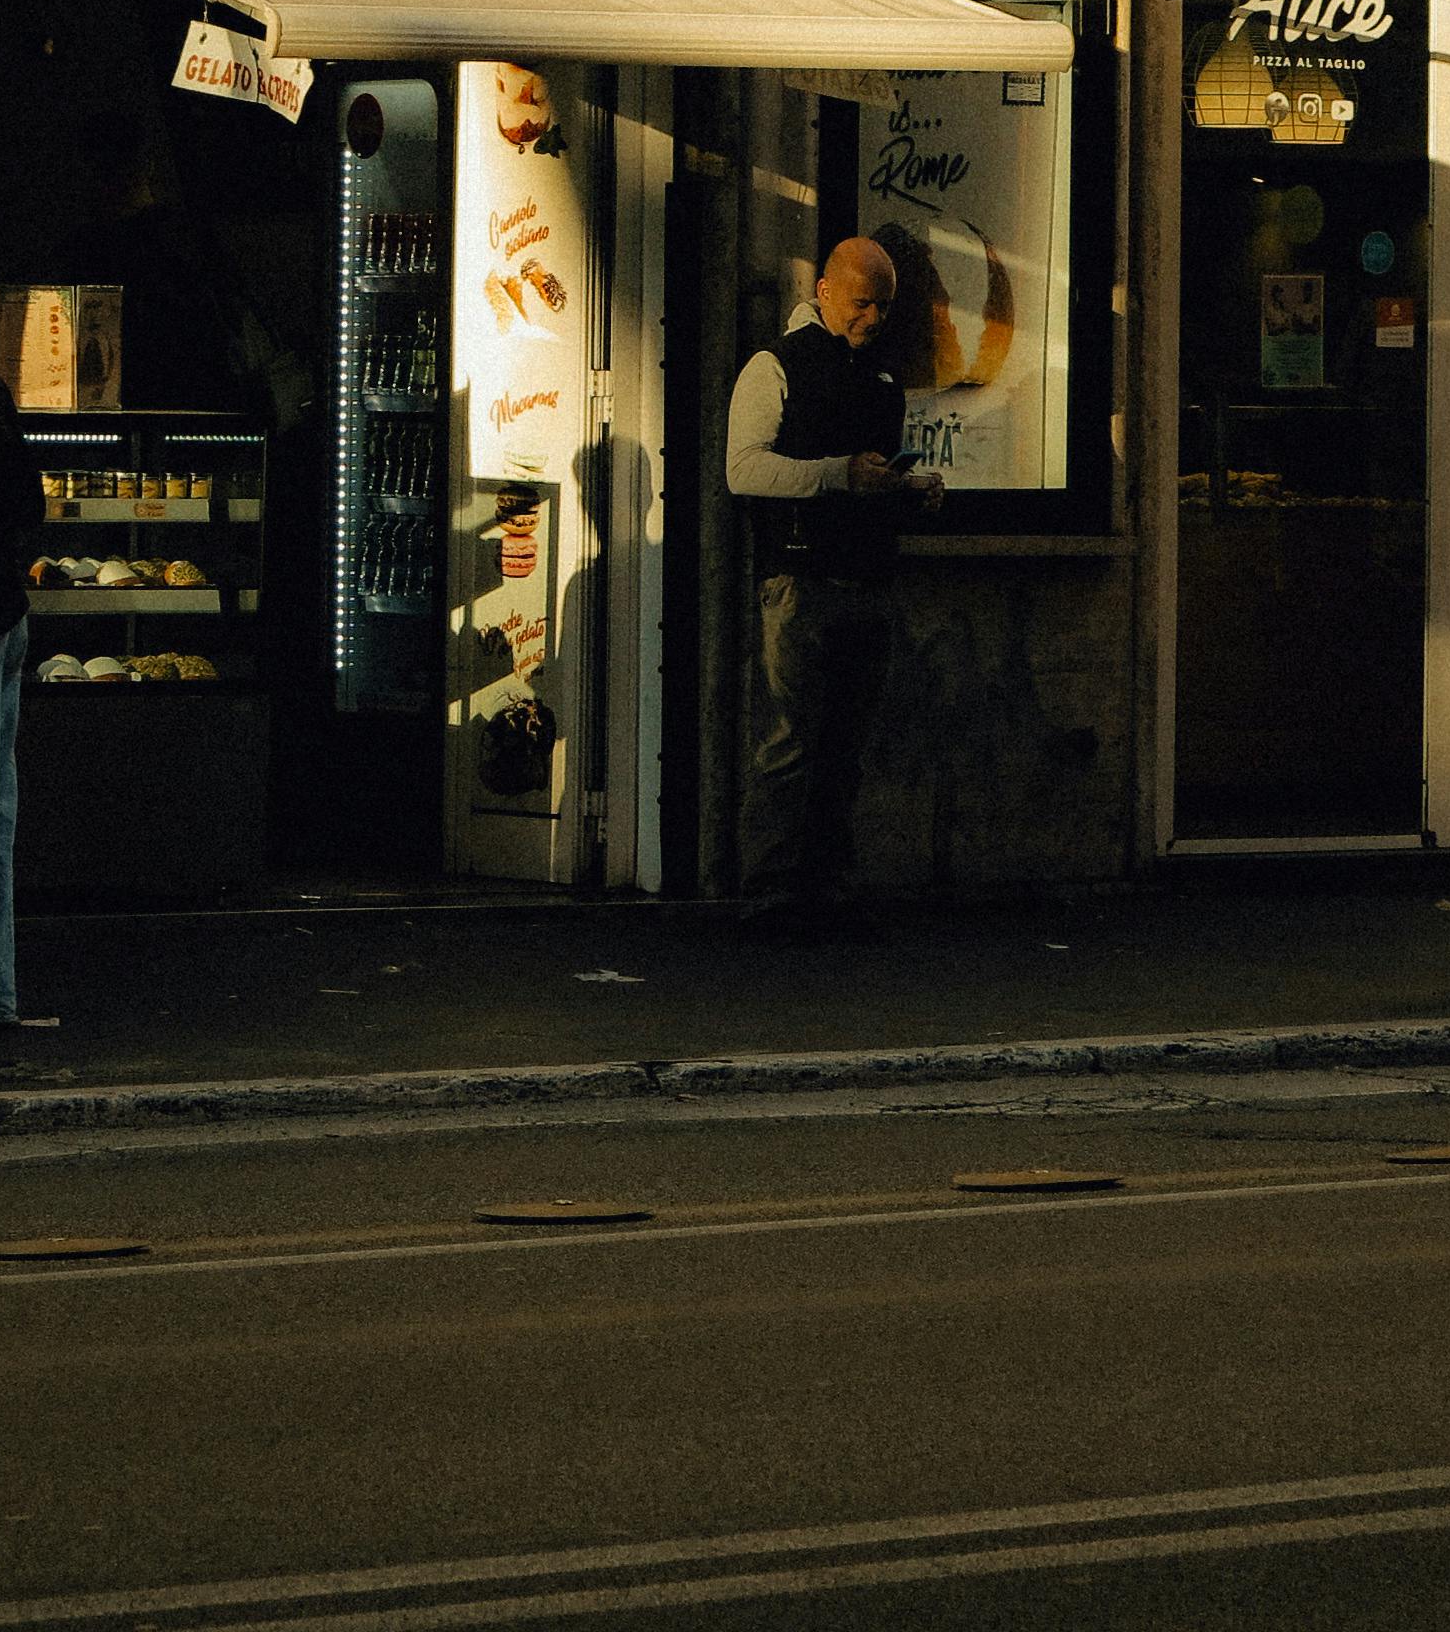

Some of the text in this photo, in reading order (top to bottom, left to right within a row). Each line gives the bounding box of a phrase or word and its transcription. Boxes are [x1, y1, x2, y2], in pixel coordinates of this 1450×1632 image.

[184, 54, 253, 92] GELATO
[1252, 54, 1367, 71] PIZZA AL TAGLIO
[868, 135, 971, 212] Rome
